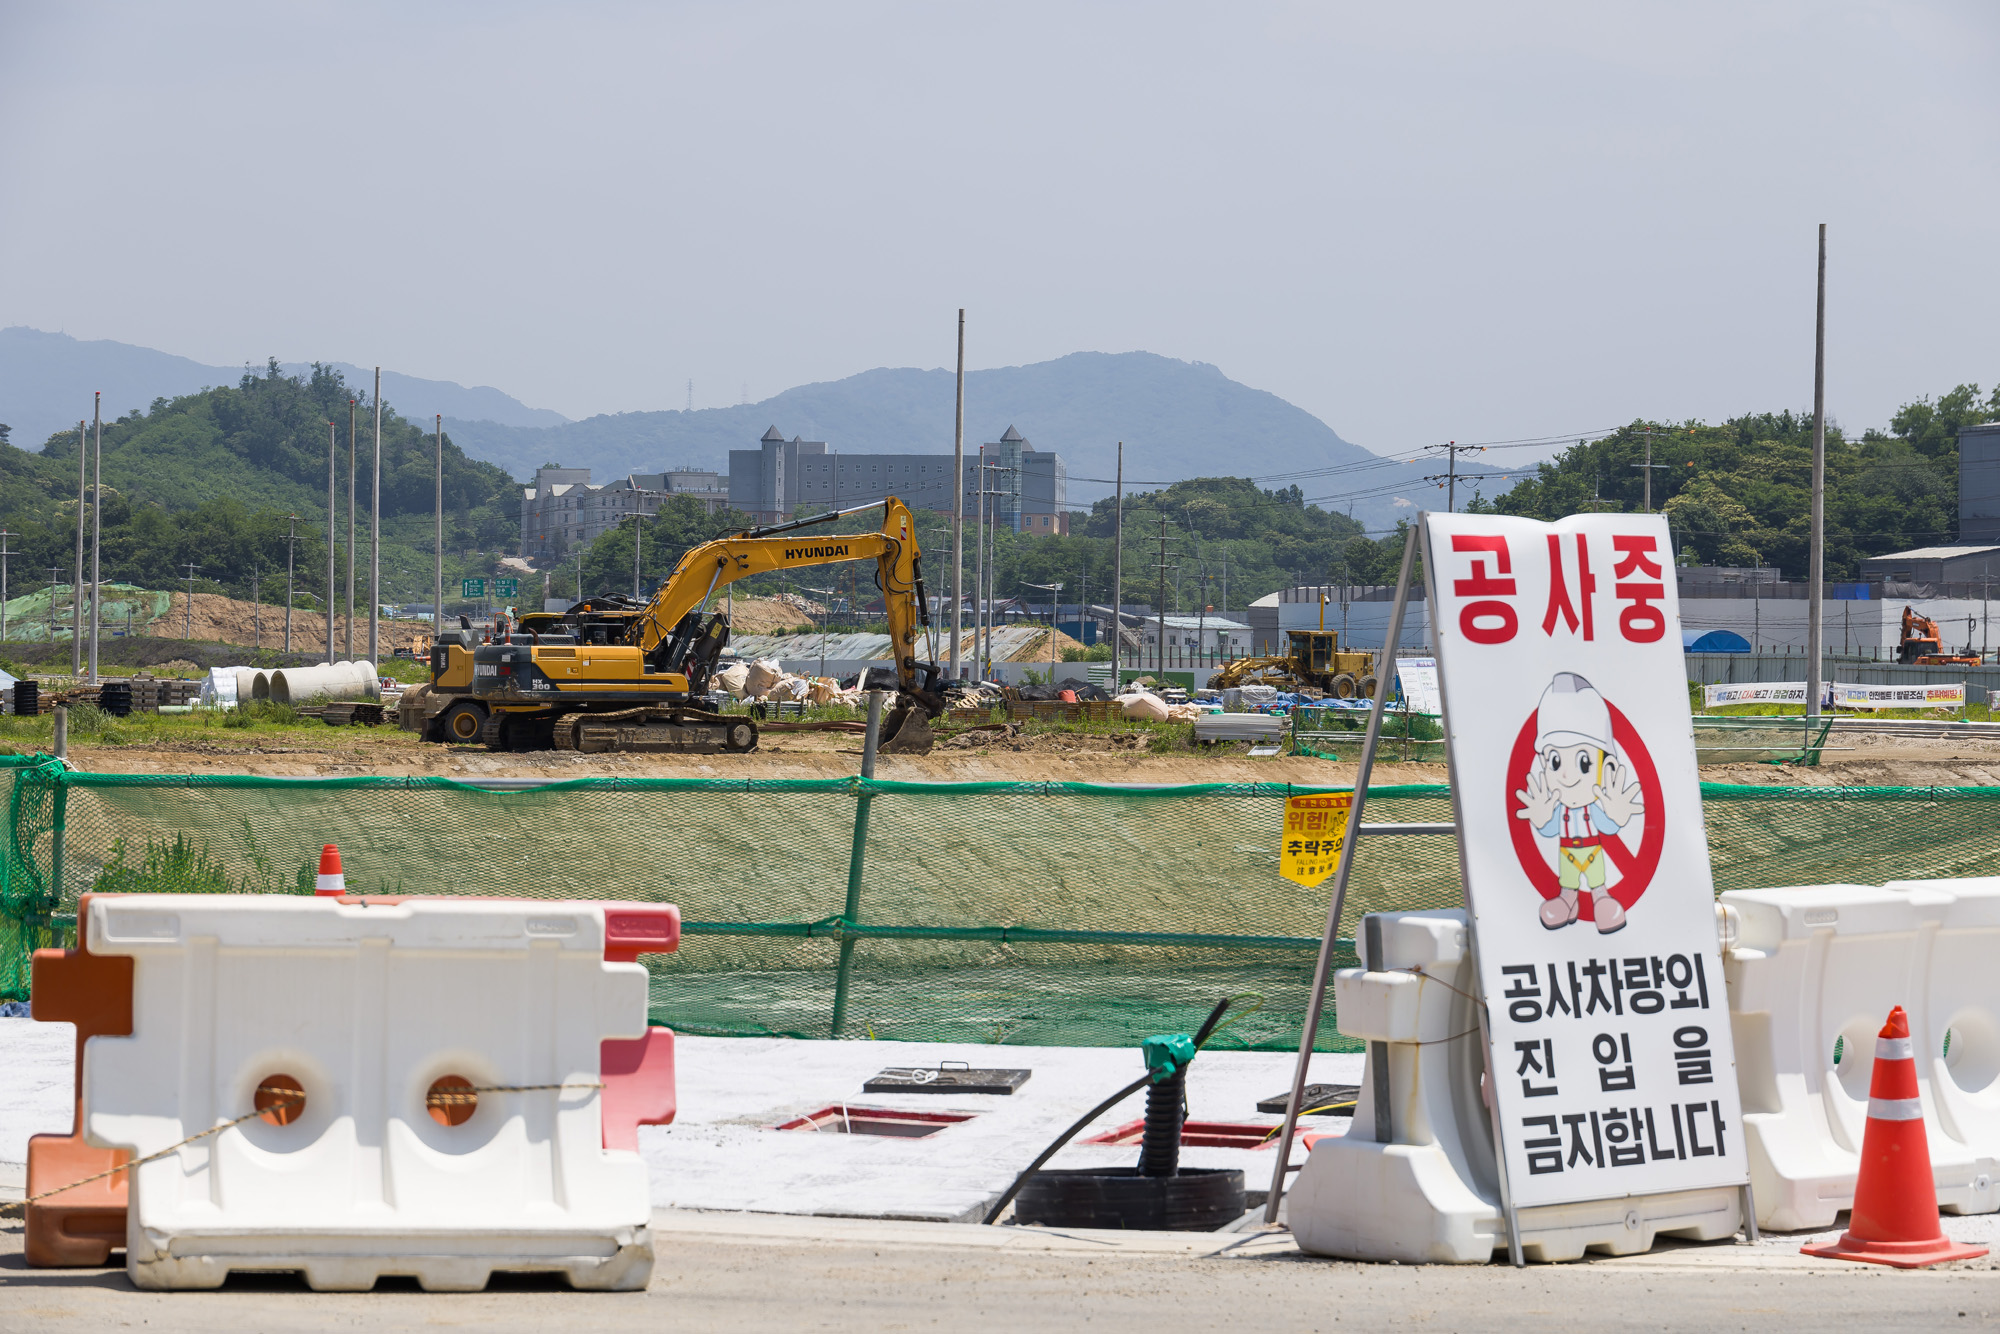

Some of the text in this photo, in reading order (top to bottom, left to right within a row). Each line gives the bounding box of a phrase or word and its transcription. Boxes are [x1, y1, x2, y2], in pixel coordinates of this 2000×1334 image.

[785, 545, 849, 560] HYUNDAI
[1288, 811, 1328, 831] 위험!
[1501, 953, 1709, 1023] 공사차량외
[1522, 1100, 1726, 1175] 금지합니다
